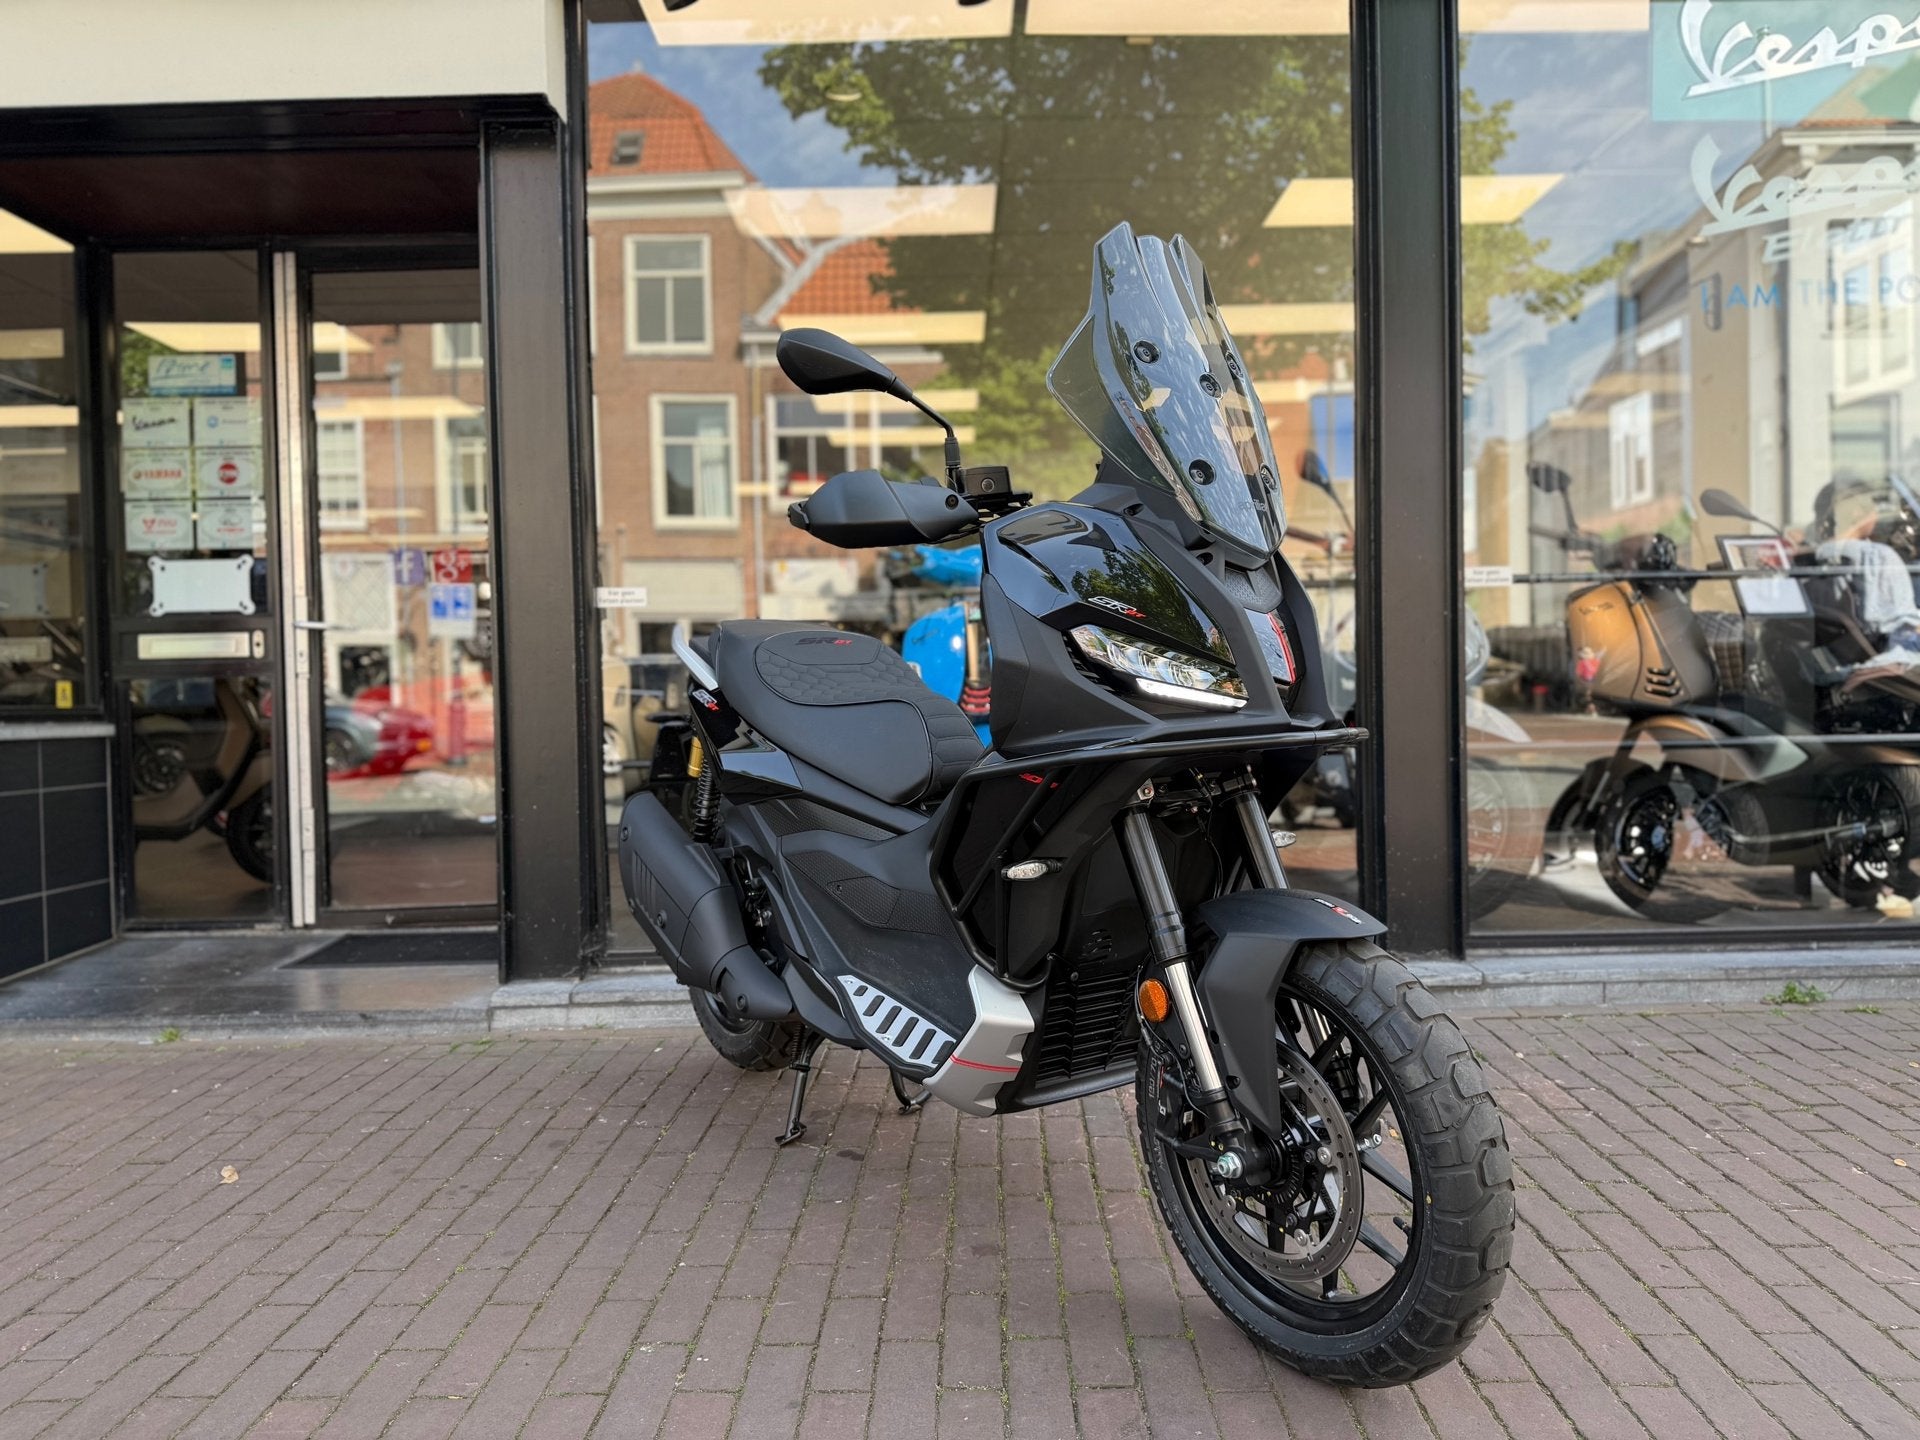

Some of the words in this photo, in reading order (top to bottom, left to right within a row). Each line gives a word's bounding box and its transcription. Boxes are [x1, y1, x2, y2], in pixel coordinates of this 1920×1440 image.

[1681, 0, 1920, 97] Vesp
[1726, 283, 1781, 309] AM
[1799, 278, 1858, 305] THE
